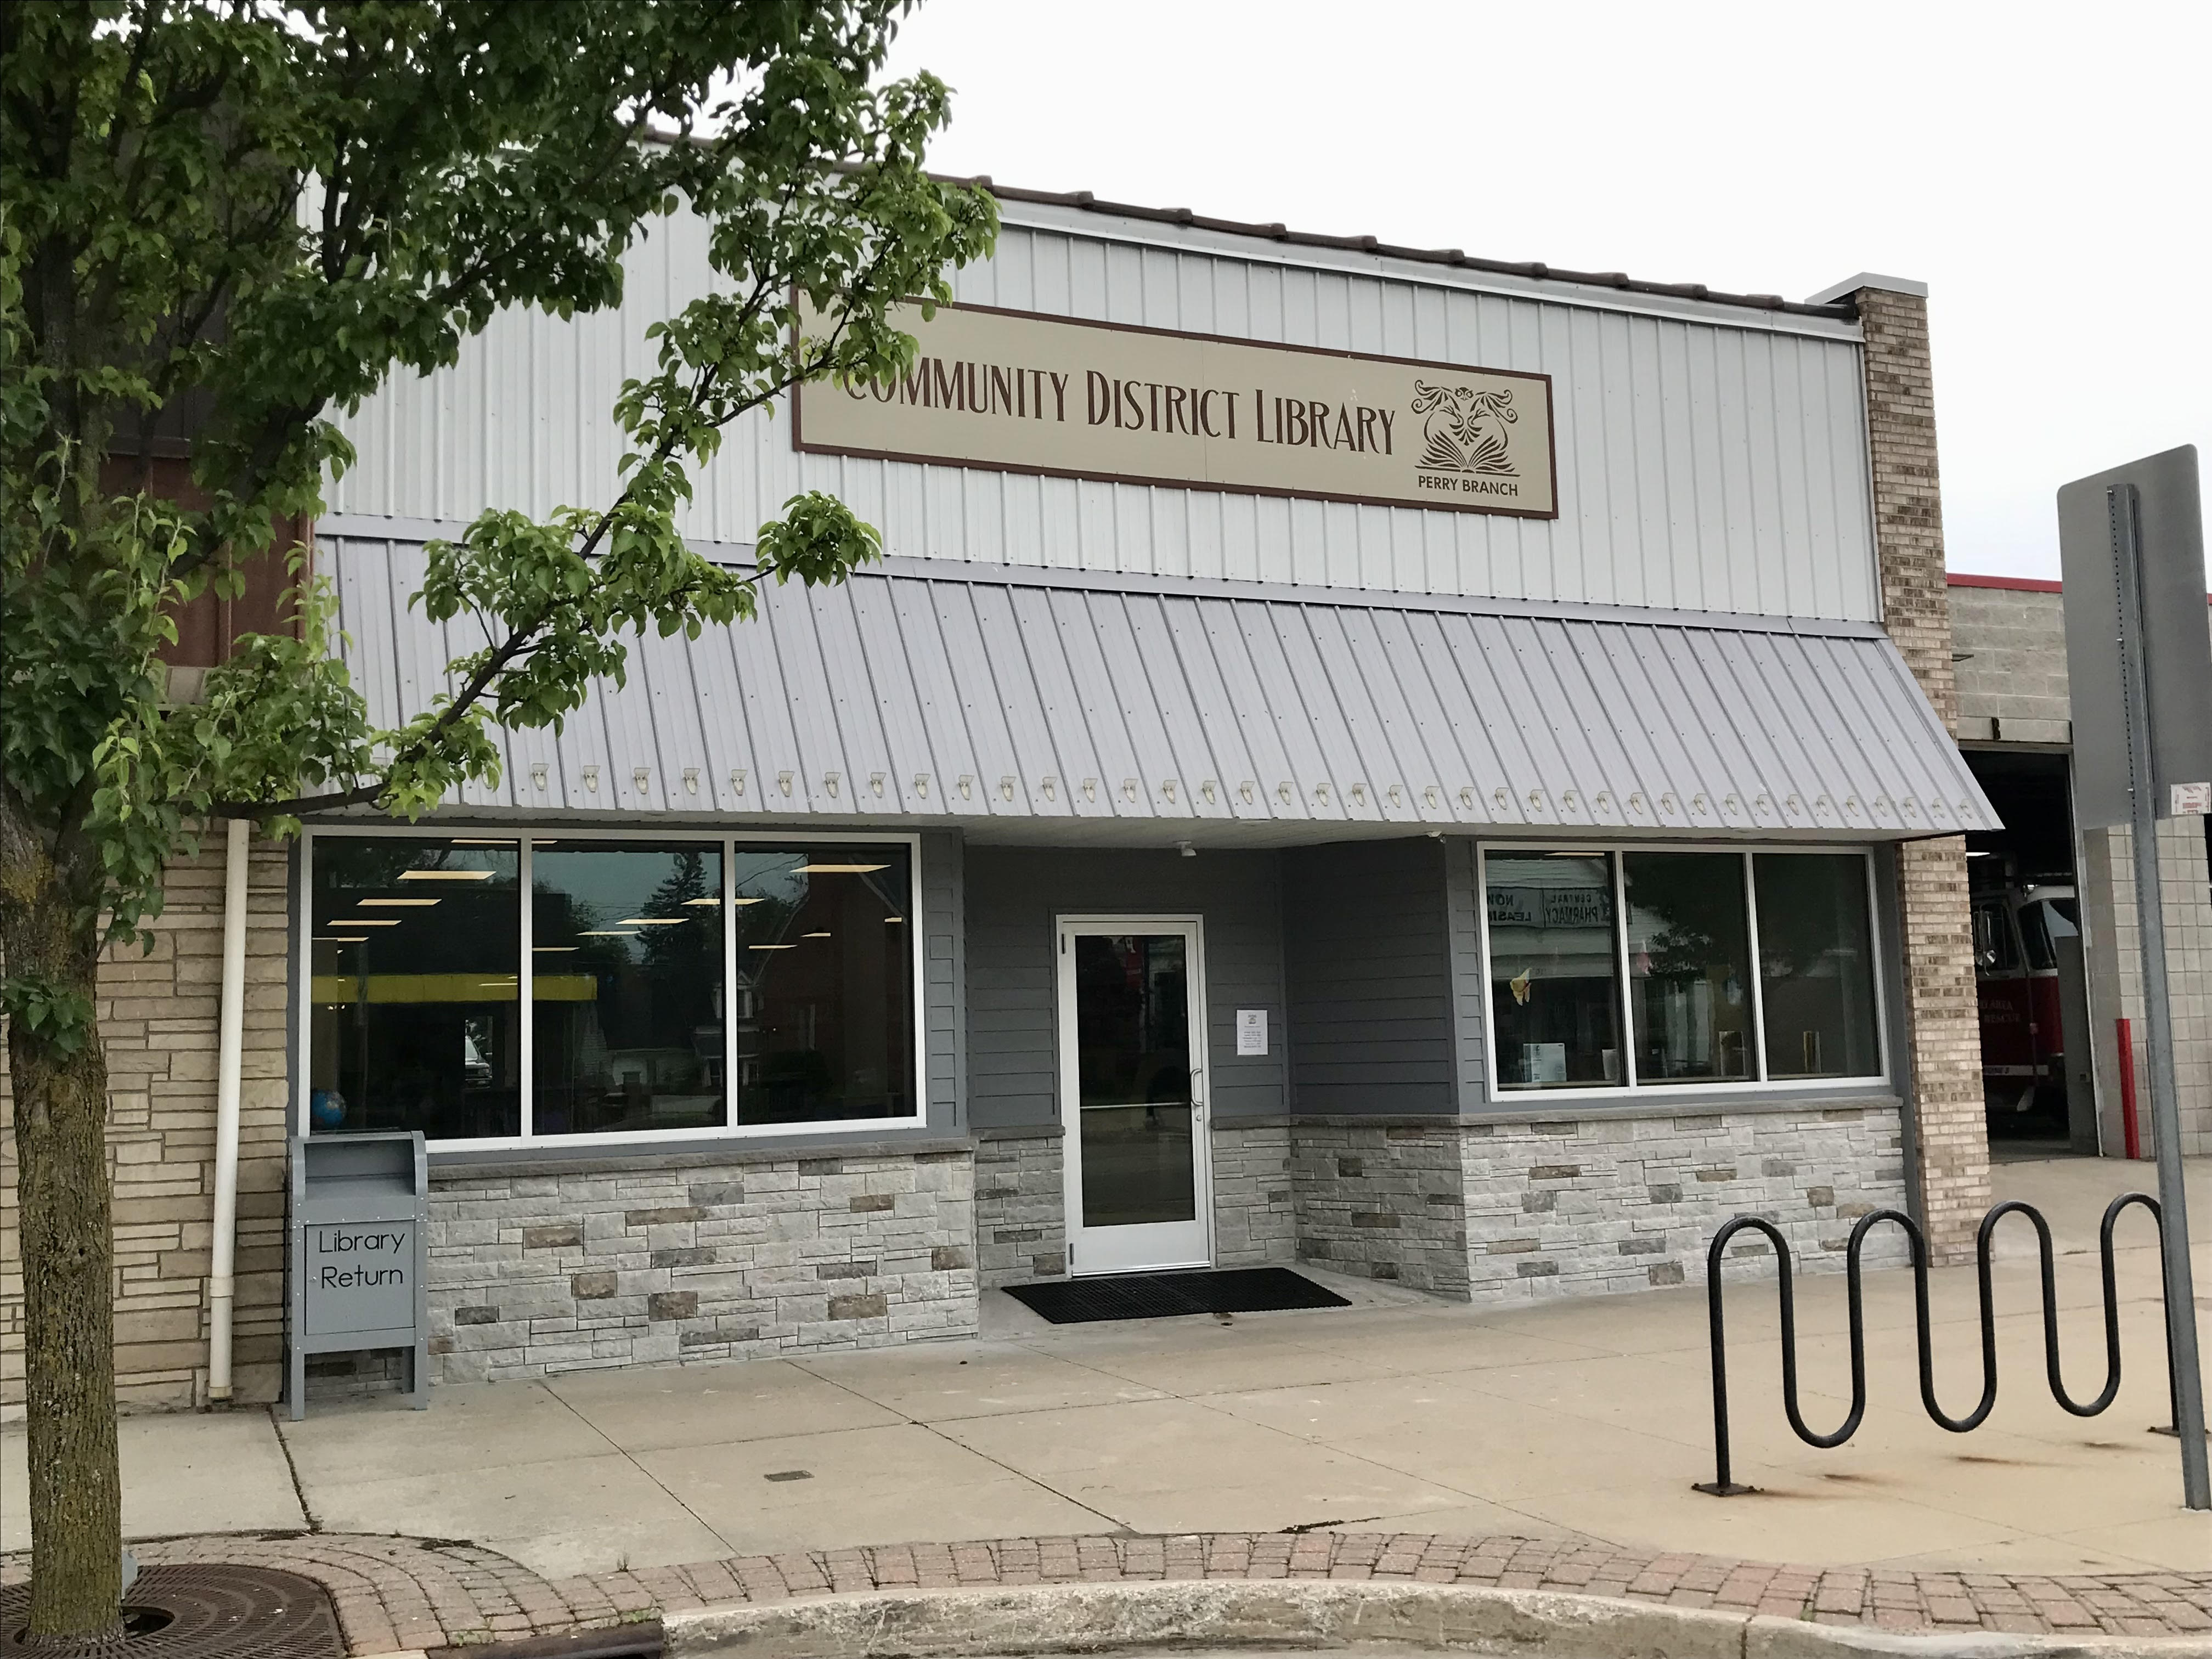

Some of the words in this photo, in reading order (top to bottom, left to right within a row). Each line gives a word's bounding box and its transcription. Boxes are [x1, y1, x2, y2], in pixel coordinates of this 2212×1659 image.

[1086, 370, 1240, 439] DISTRICT
[1255, 389, 1395, 455] LIBRARY
[1418, 475, 1458, 491] PERRY
[1462, 479, 1519, 496] BRANCH
[319, 1229, 405, 1254] Library
[321, 1264, 403, 1289] Return
